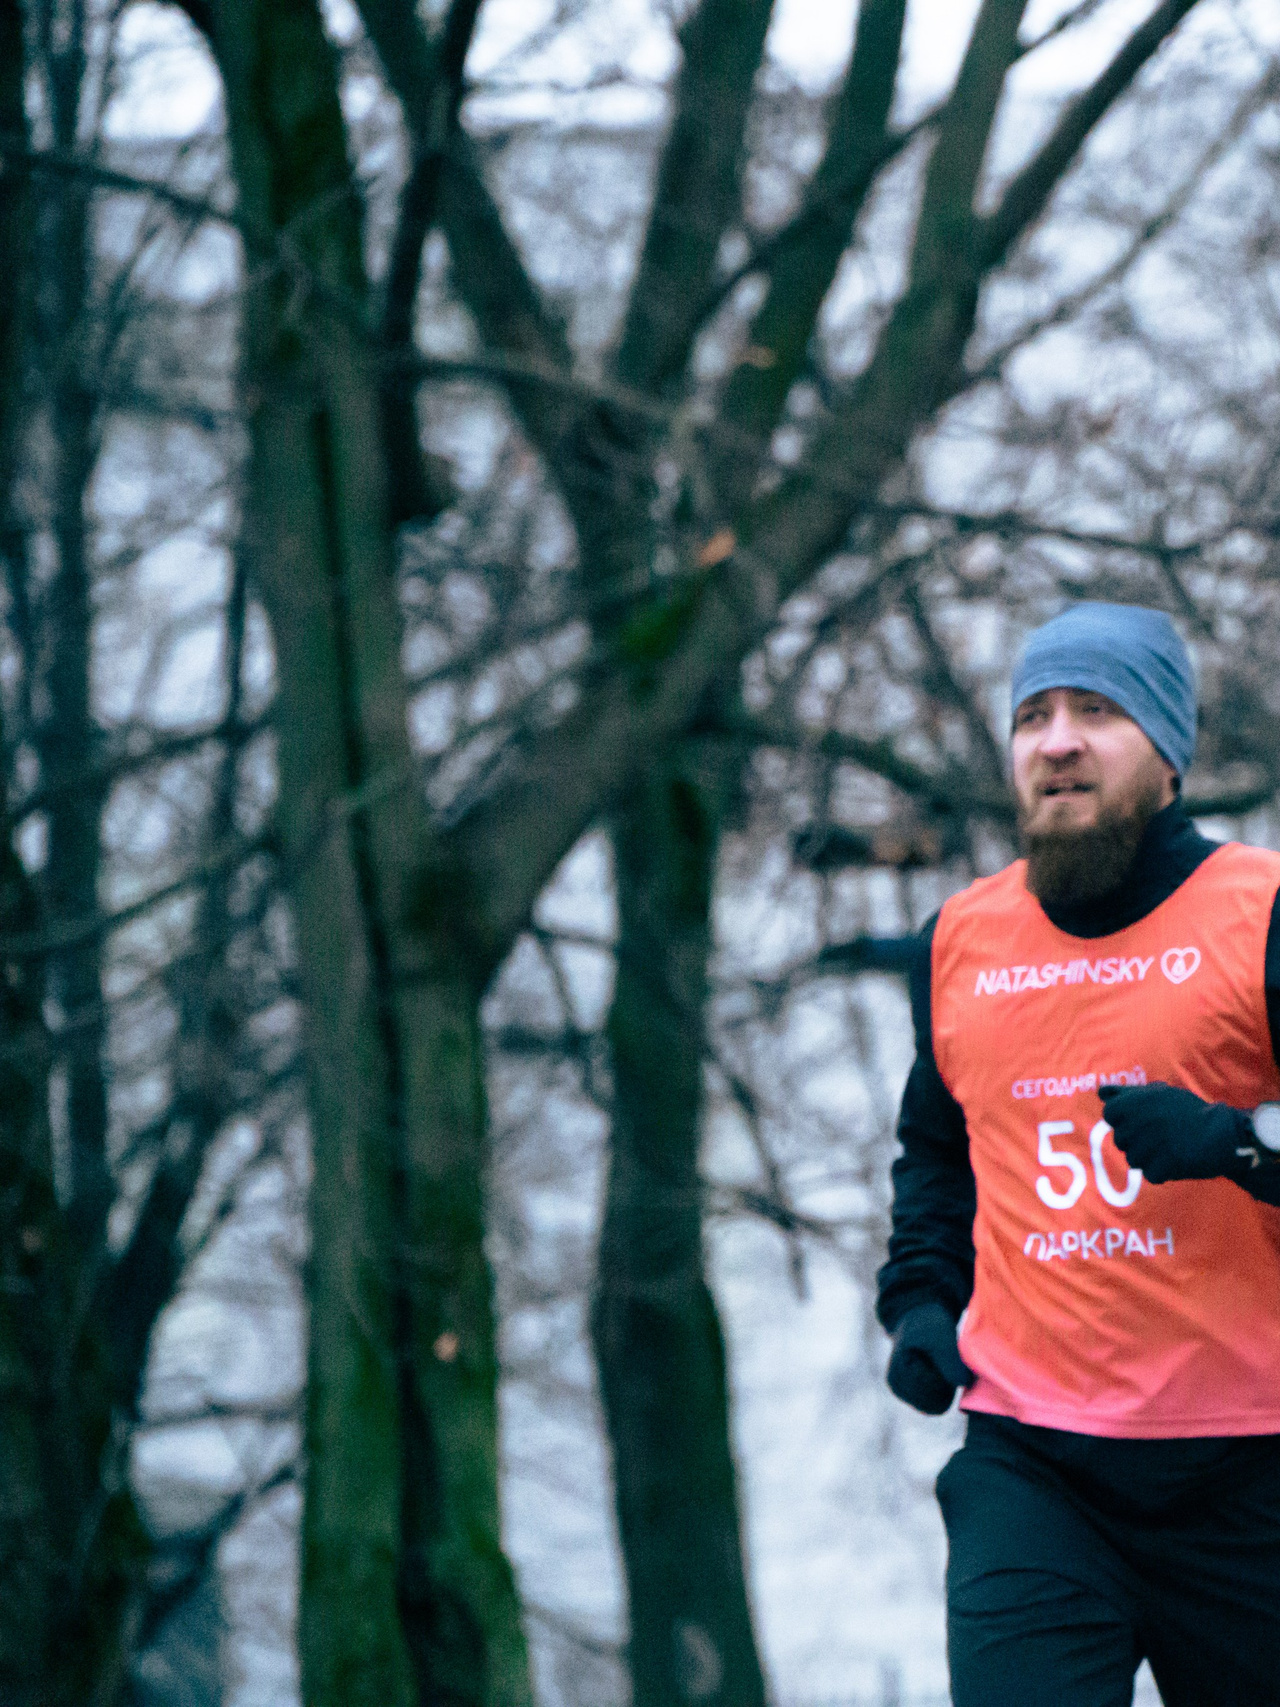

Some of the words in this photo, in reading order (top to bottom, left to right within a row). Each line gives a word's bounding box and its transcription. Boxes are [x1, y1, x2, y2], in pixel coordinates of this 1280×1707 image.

[975, 956, 1154, 997] NATASHINSKY
[1011, 1073, 1097, 1099] СЕГОДНЯ
[1036, 1120, 1143, 1210] 50
[1023, 1227, 1175, 1261] ПАРКРАН
